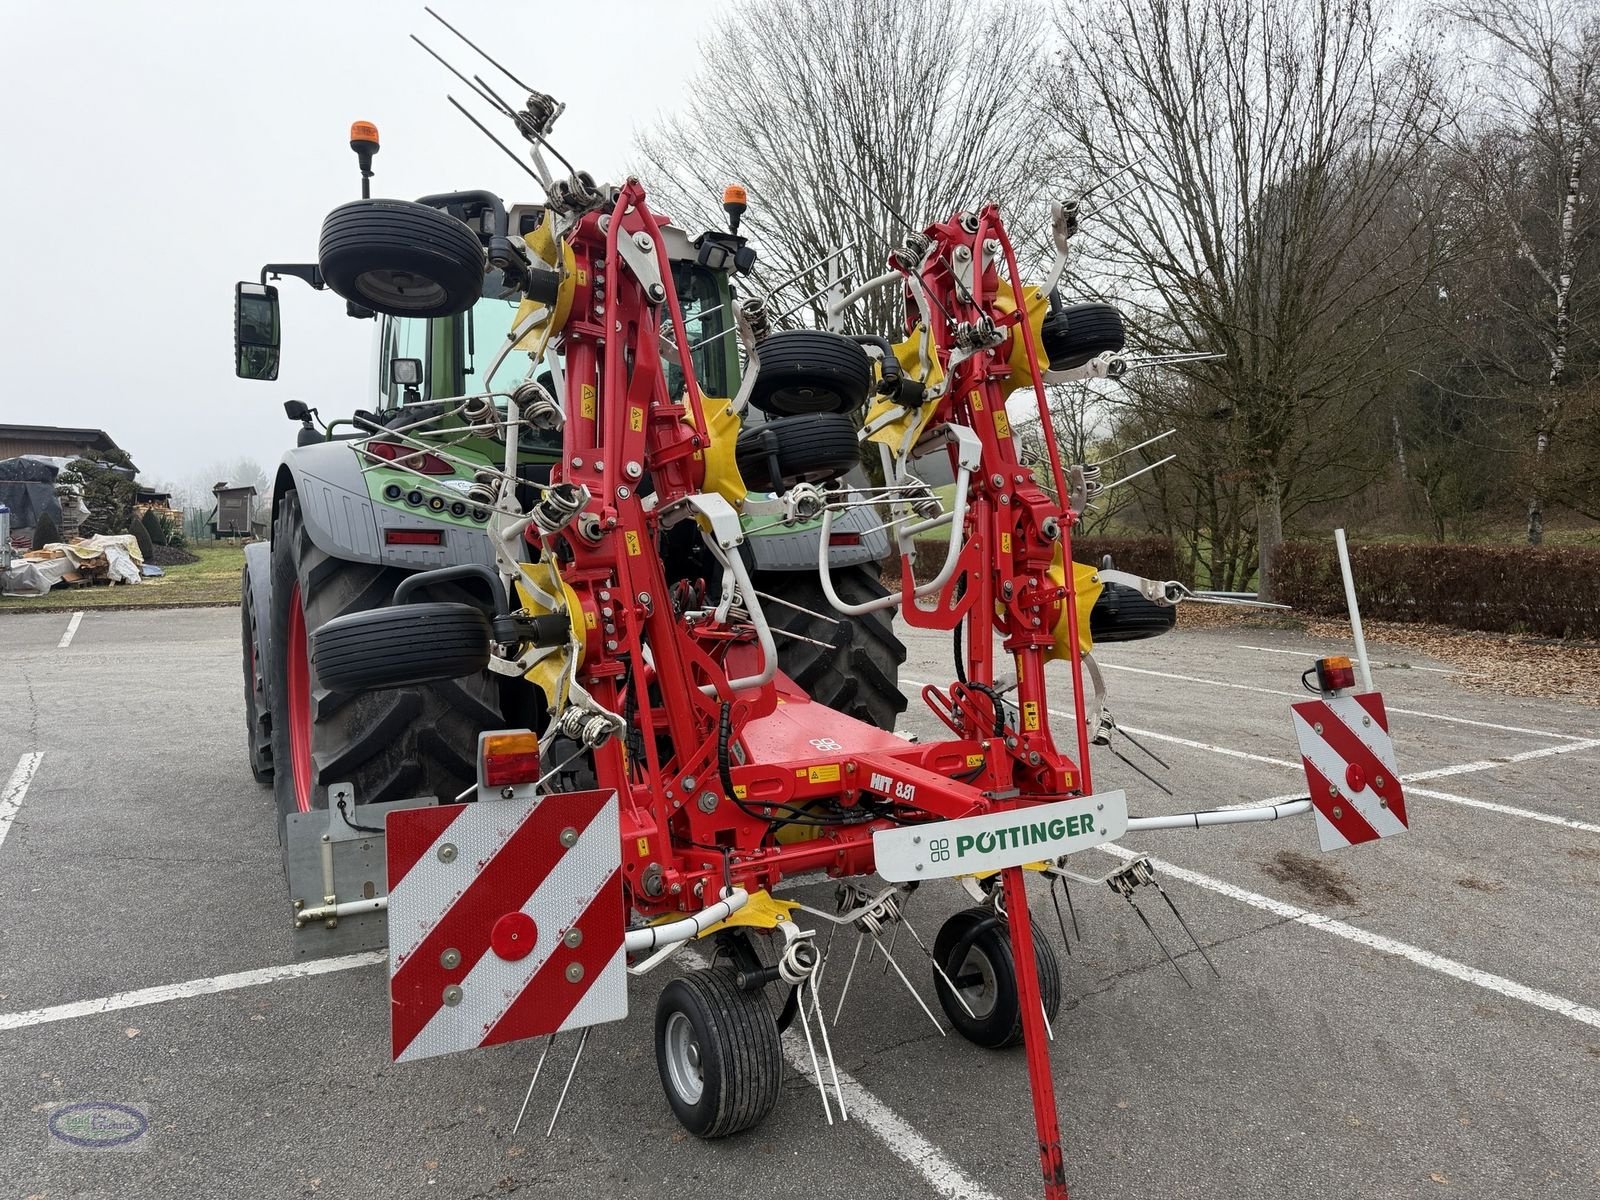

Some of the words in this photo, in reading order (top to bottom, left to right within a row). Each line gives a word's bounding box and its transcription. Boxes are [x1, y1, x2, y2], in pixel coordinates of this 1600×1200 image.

[870, 772, 893, 794] HIT
[895, 781, 916, 802] 8.81
[956, 813, 1096, 858] PÖTTINGER
